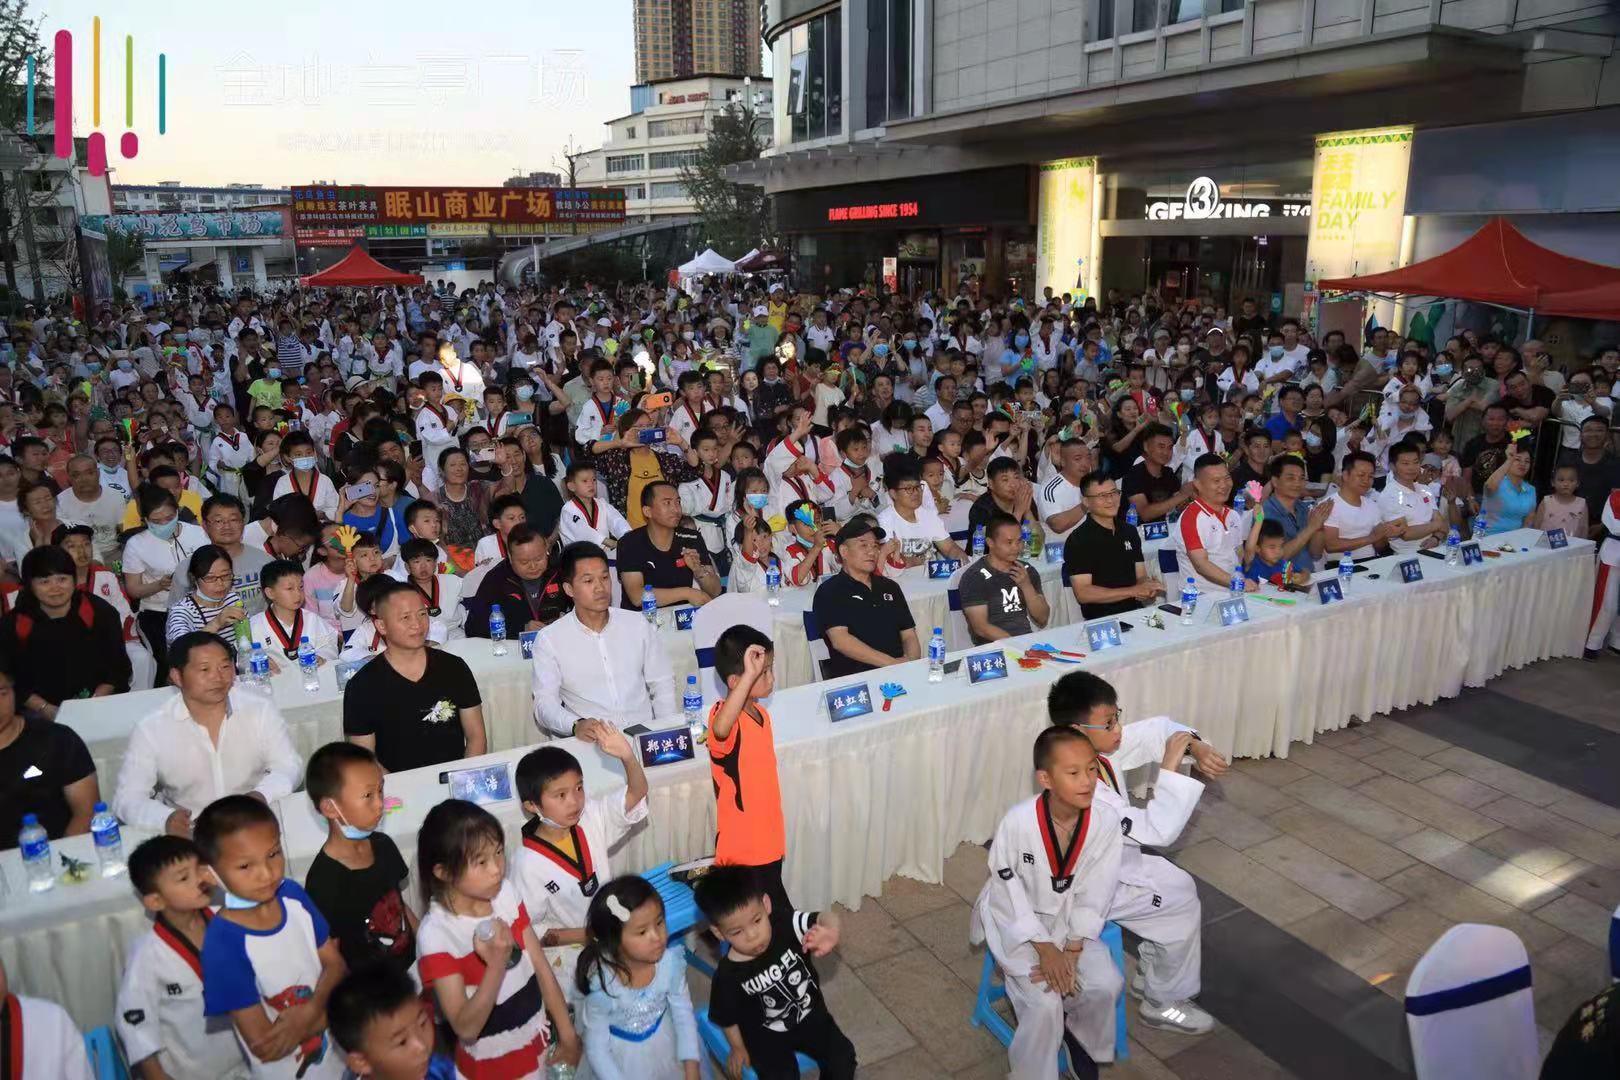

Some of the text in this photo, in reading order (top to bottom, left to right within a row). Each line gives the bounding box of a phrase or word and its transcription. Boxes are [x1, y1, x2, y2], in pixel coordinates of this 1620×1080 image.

[900, 202, 918, 216] 1954
[1319, 191, 1397, 209] FAMILY
[1317, 211, 1361, 230] DAY
[972, 657, 1006, 672] 胡宝林
[646, 735, 688, 756] 郑洪富
